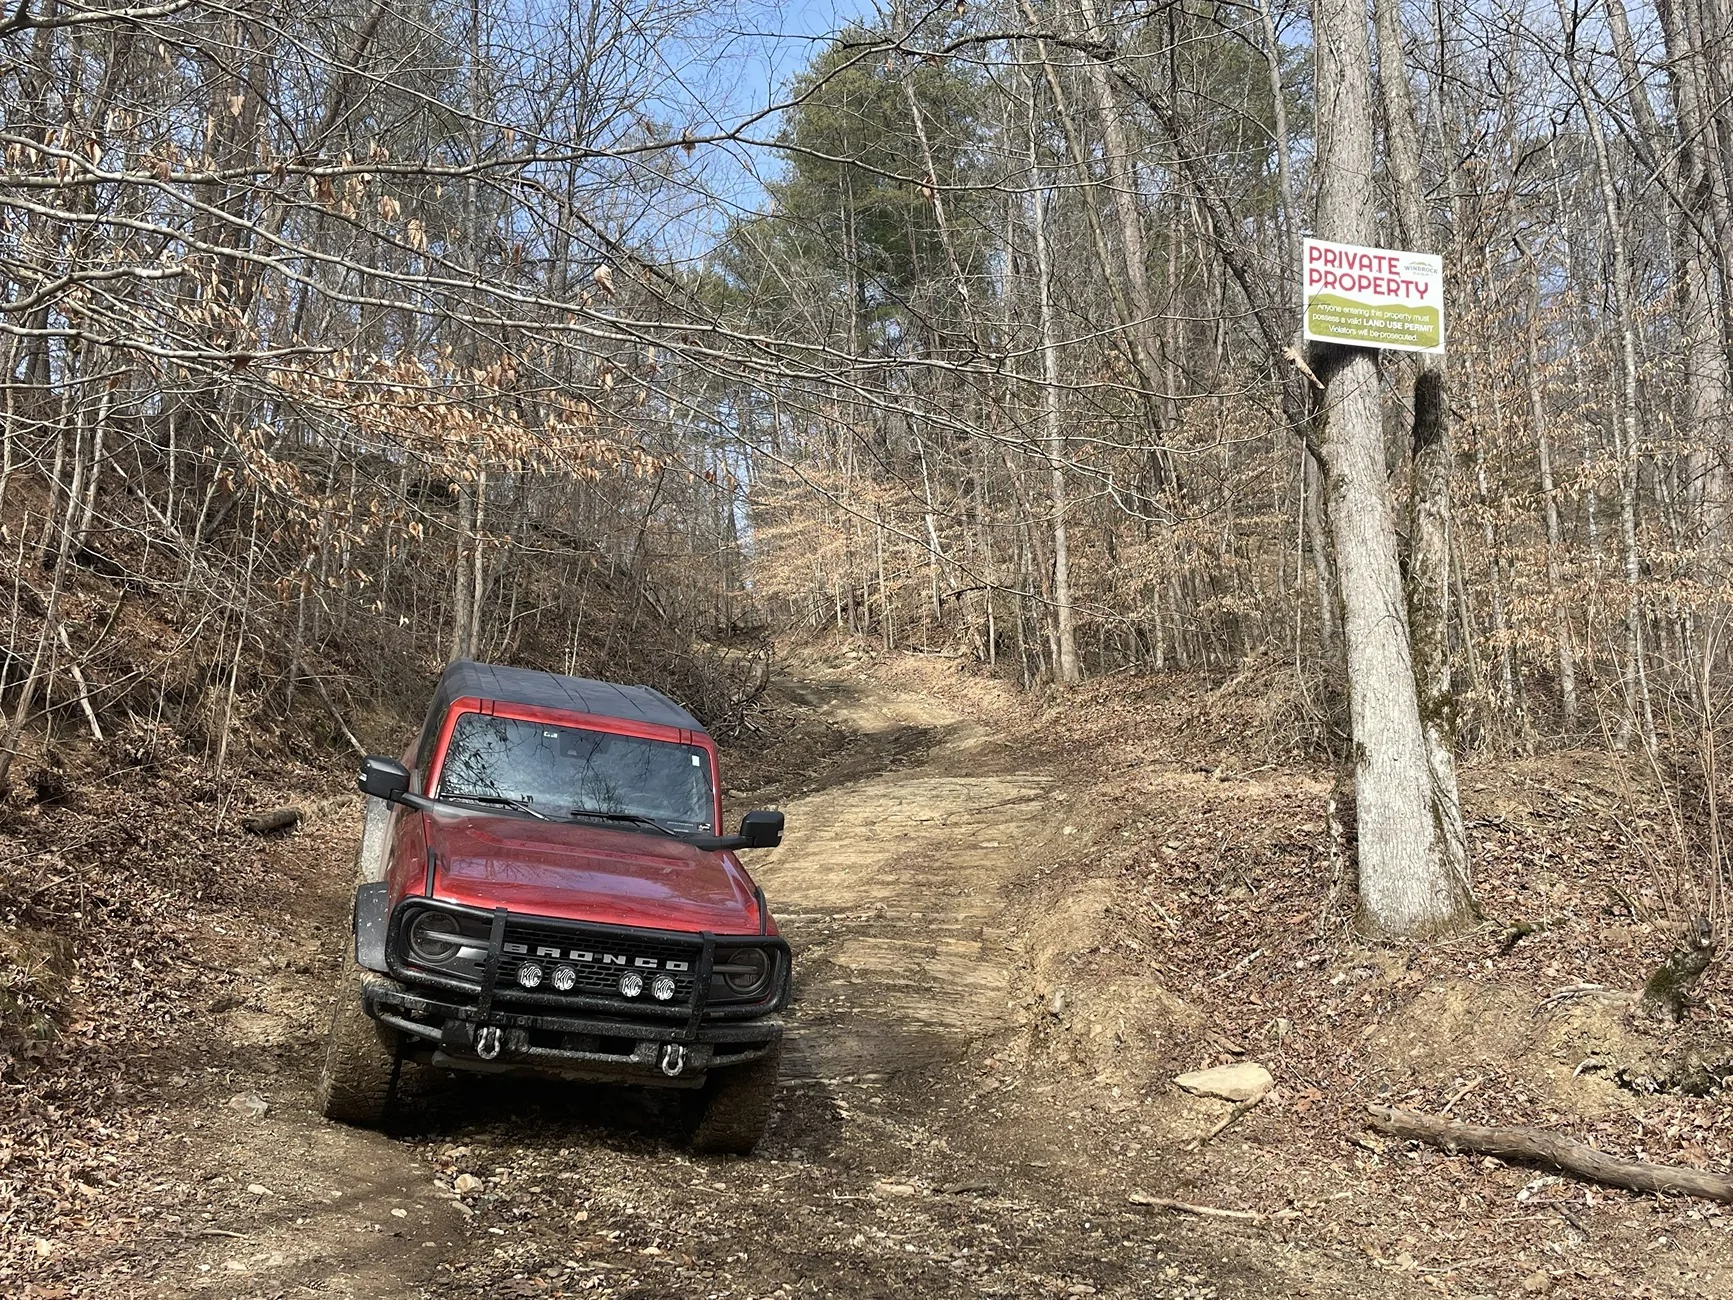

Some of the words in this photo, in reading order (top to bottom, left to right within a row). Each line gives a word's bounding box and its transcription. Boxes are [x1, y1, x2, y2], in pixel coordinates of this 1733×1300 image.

[1309, 246, 1400, 276] PRIVATE
[1309, 268, 1429, 300] PROPERTY
[1312, 313, 1341, 324] possess
[1346, 316, 1363, 326] valid
[1363, 318, 1386, 329] LAND
[1386, 321, 1404, 330] USE
[1317, 303, 1342, 315] Anyone
[1342, 306, 1370, 318] entering
[1370, 307, 1383, 317] this
[1383, 312, 1412, 322] property
[1412, 313, 1430, 323] must
[1328, 324, 1357, 336] Violators
[1357, 327, 1369, 337] will
[1369, 328, 1380, 338] be
[1380, 331, 1419, 342] prosecuted.
[503, 942, 689, 972] BRONCO
[520, 966, 542, 988] KC
[554, 968, 576, 991] KC
[620, 975, 643, 998] KC
[653, 978, 676, 1001] KC
